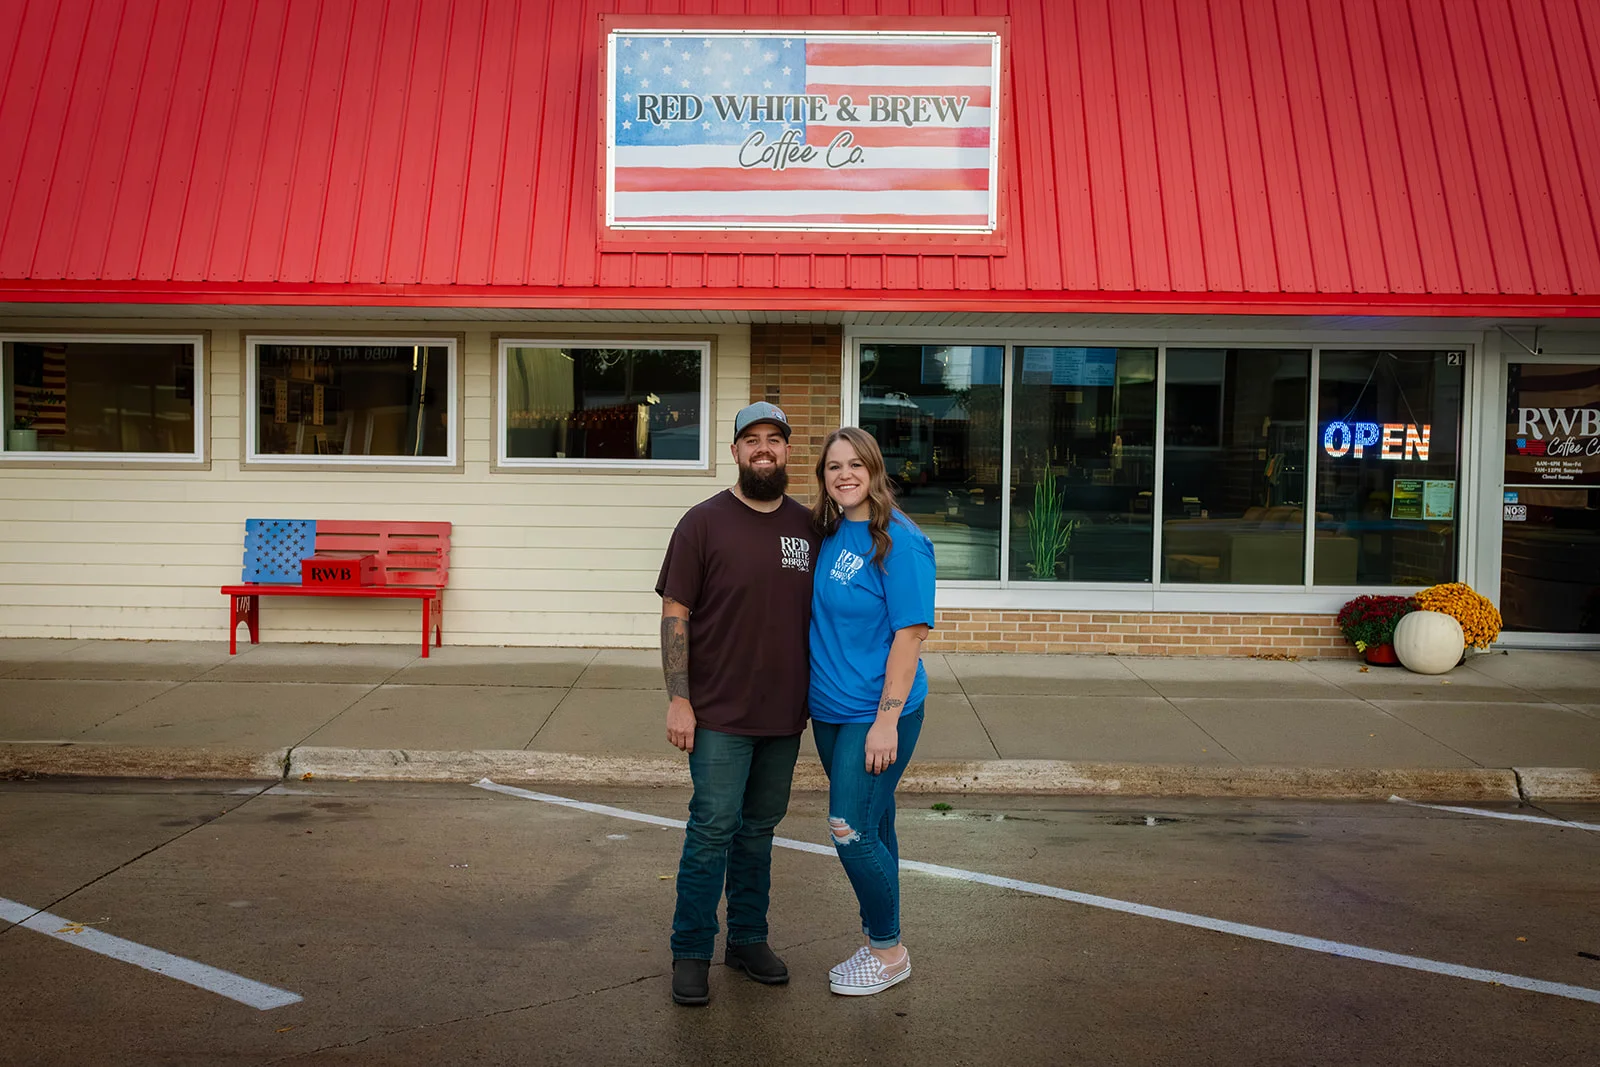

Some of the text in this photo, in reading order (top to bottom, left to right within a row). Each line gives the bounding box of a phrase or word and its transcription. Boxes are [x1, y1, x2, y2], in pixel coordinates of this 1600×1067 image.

[637, 94, 970, 127] RED WHITE & BREW
[739, 130, 865, 170] Coffee Co.
[1449, 353, 1461, 365] 21
[1516, 407, 1600, 440] RWB
[1324, 421, 1431, 461] OPEN
[1547, 436, 1583, 456] Coffee
[780, 536, 810, 552] RED
[781, 549, 809, 560] WHITE
[788, 557, 809, 567] BREW
[837, 549, 864, 570] RED
[312, 568, 351, 582] RWB
